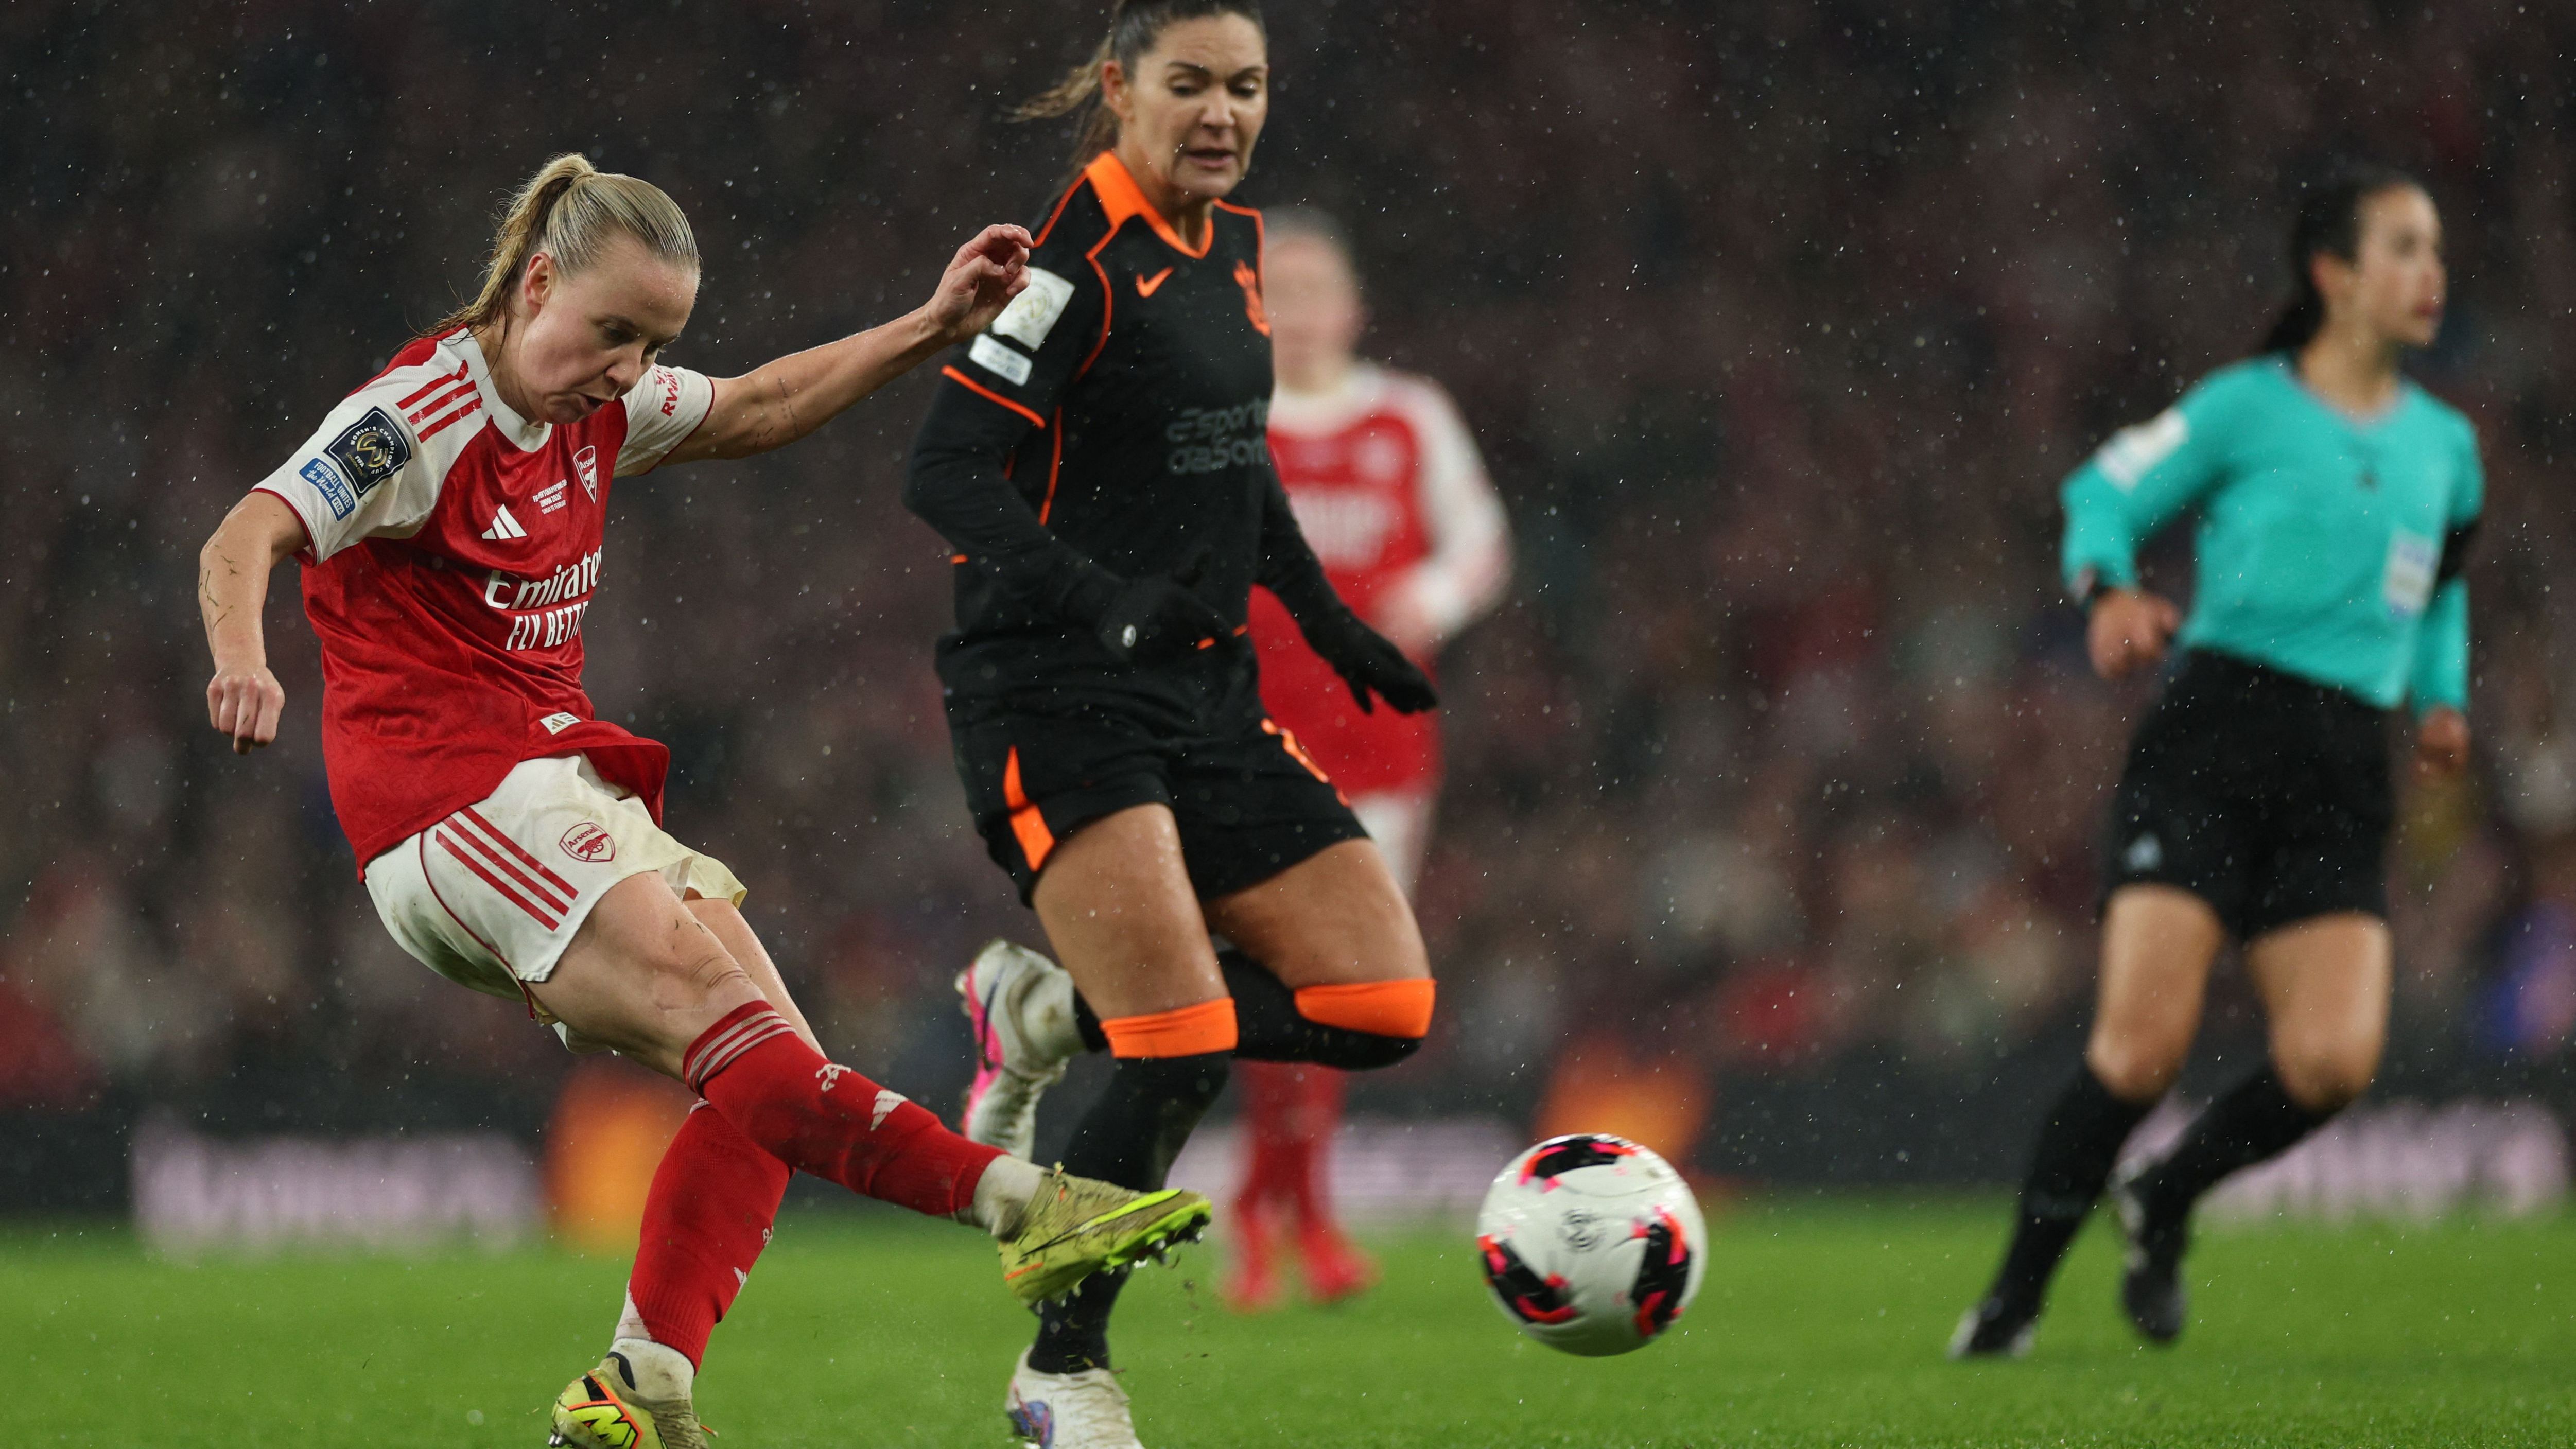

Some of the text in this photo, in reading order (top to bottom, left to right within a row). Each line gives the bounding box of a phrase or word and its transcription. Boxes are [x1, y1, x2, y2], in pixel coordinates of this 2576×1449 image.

[350, 426, 377, 445] WOMEN'S
[379, 428, 395, 469] CHAMPIONS
[355, 455, 364, 468] FIFA
[306, 469, 337, 499] the World
[314, 461, 353, 509] FOOTBALL UNITES
[334, 499, 343, 514] FIFA
[506, 601, 589, 651] FLY BETT
[568, 827, 598, 848] Arsenal
